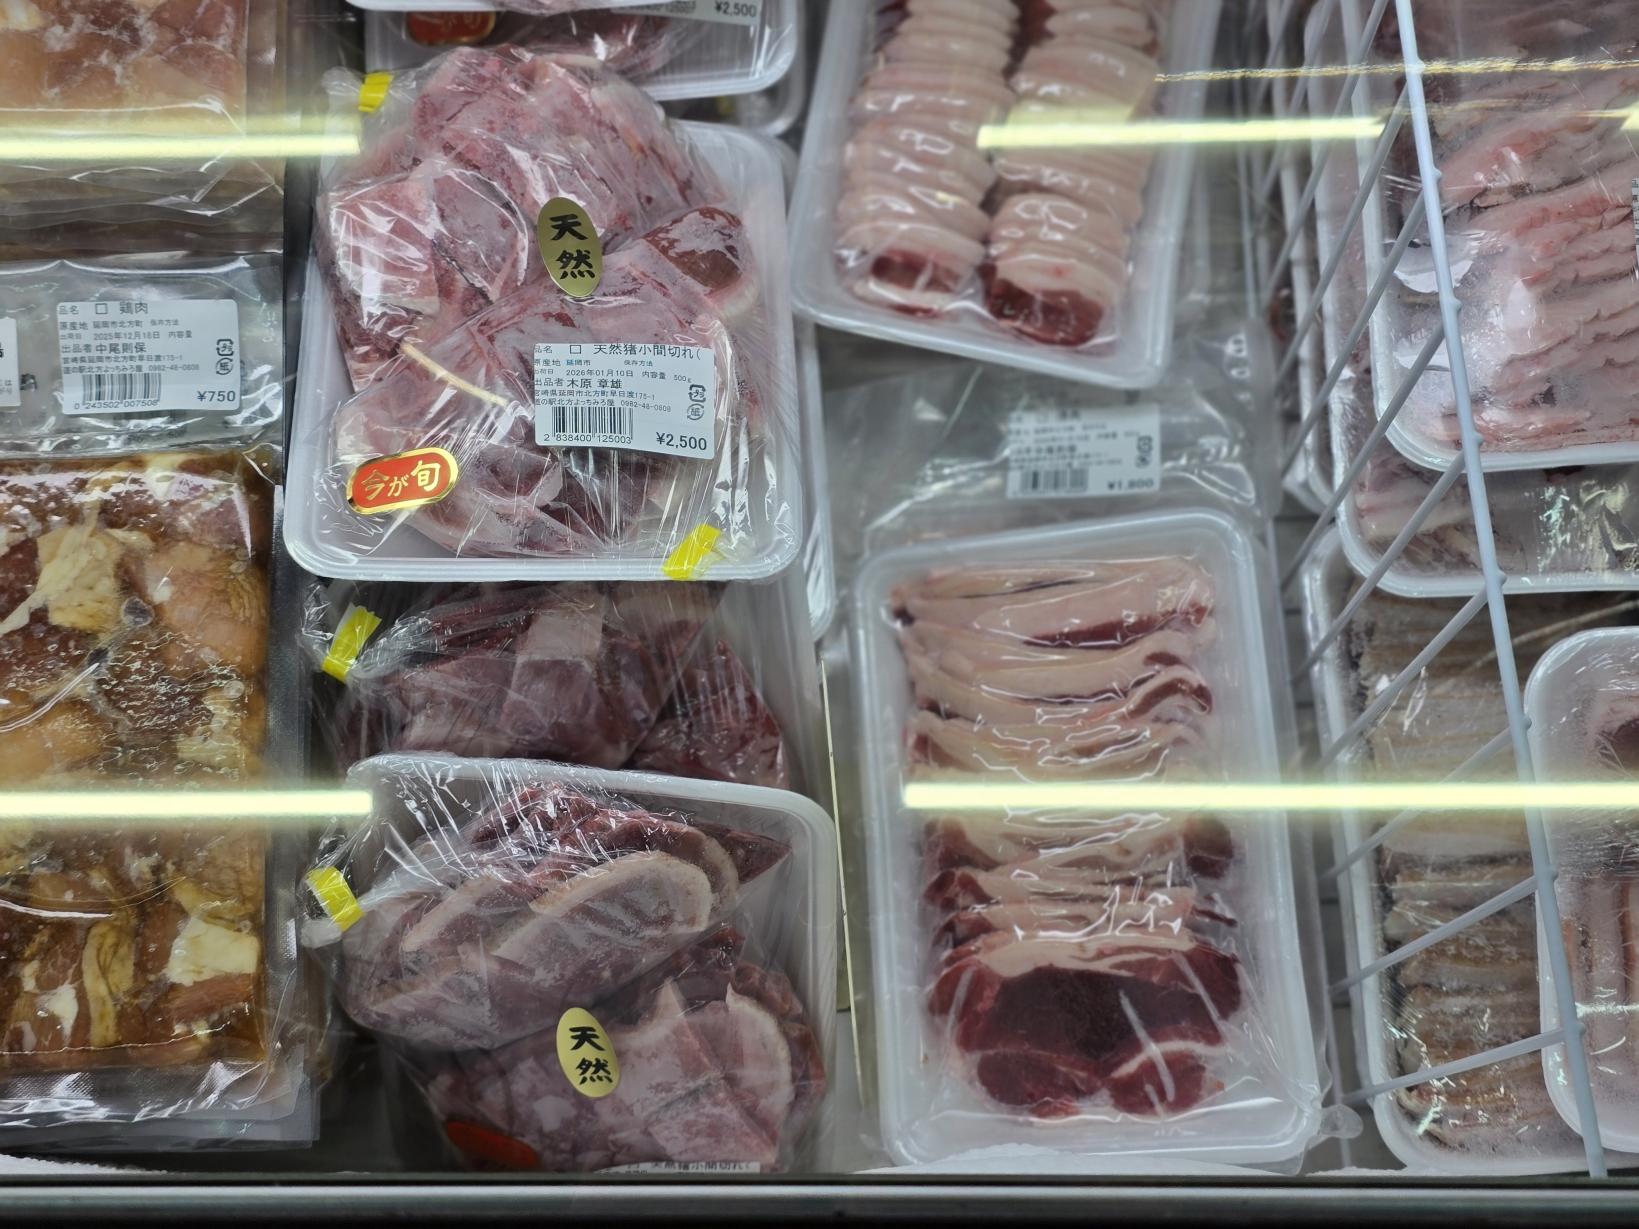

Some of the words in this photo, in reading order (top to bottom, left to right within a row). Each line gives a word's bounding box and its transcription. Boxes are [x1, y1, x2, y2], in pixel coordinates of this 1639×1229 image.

[714, 1, 757, 17] ¥2,500
[550, 213, 596, 280] 天然
[119, 301, 148, 314] 鶏肉
[95, 341, 147, 354] 中尾則保
[566, 369, 633, 377] 2026年01月10日
[642, 371, 666, 380] 内容量
[197, 390, 236, 402] ¥750
[555, 434, 592, 442] 838400
[597, 434, 632, 444] 125003
[655, 431, 707, 451] ¥2,500
[362, 460, 441, 502] 今が旬
[569, 1025, 613, 1085] 天然
